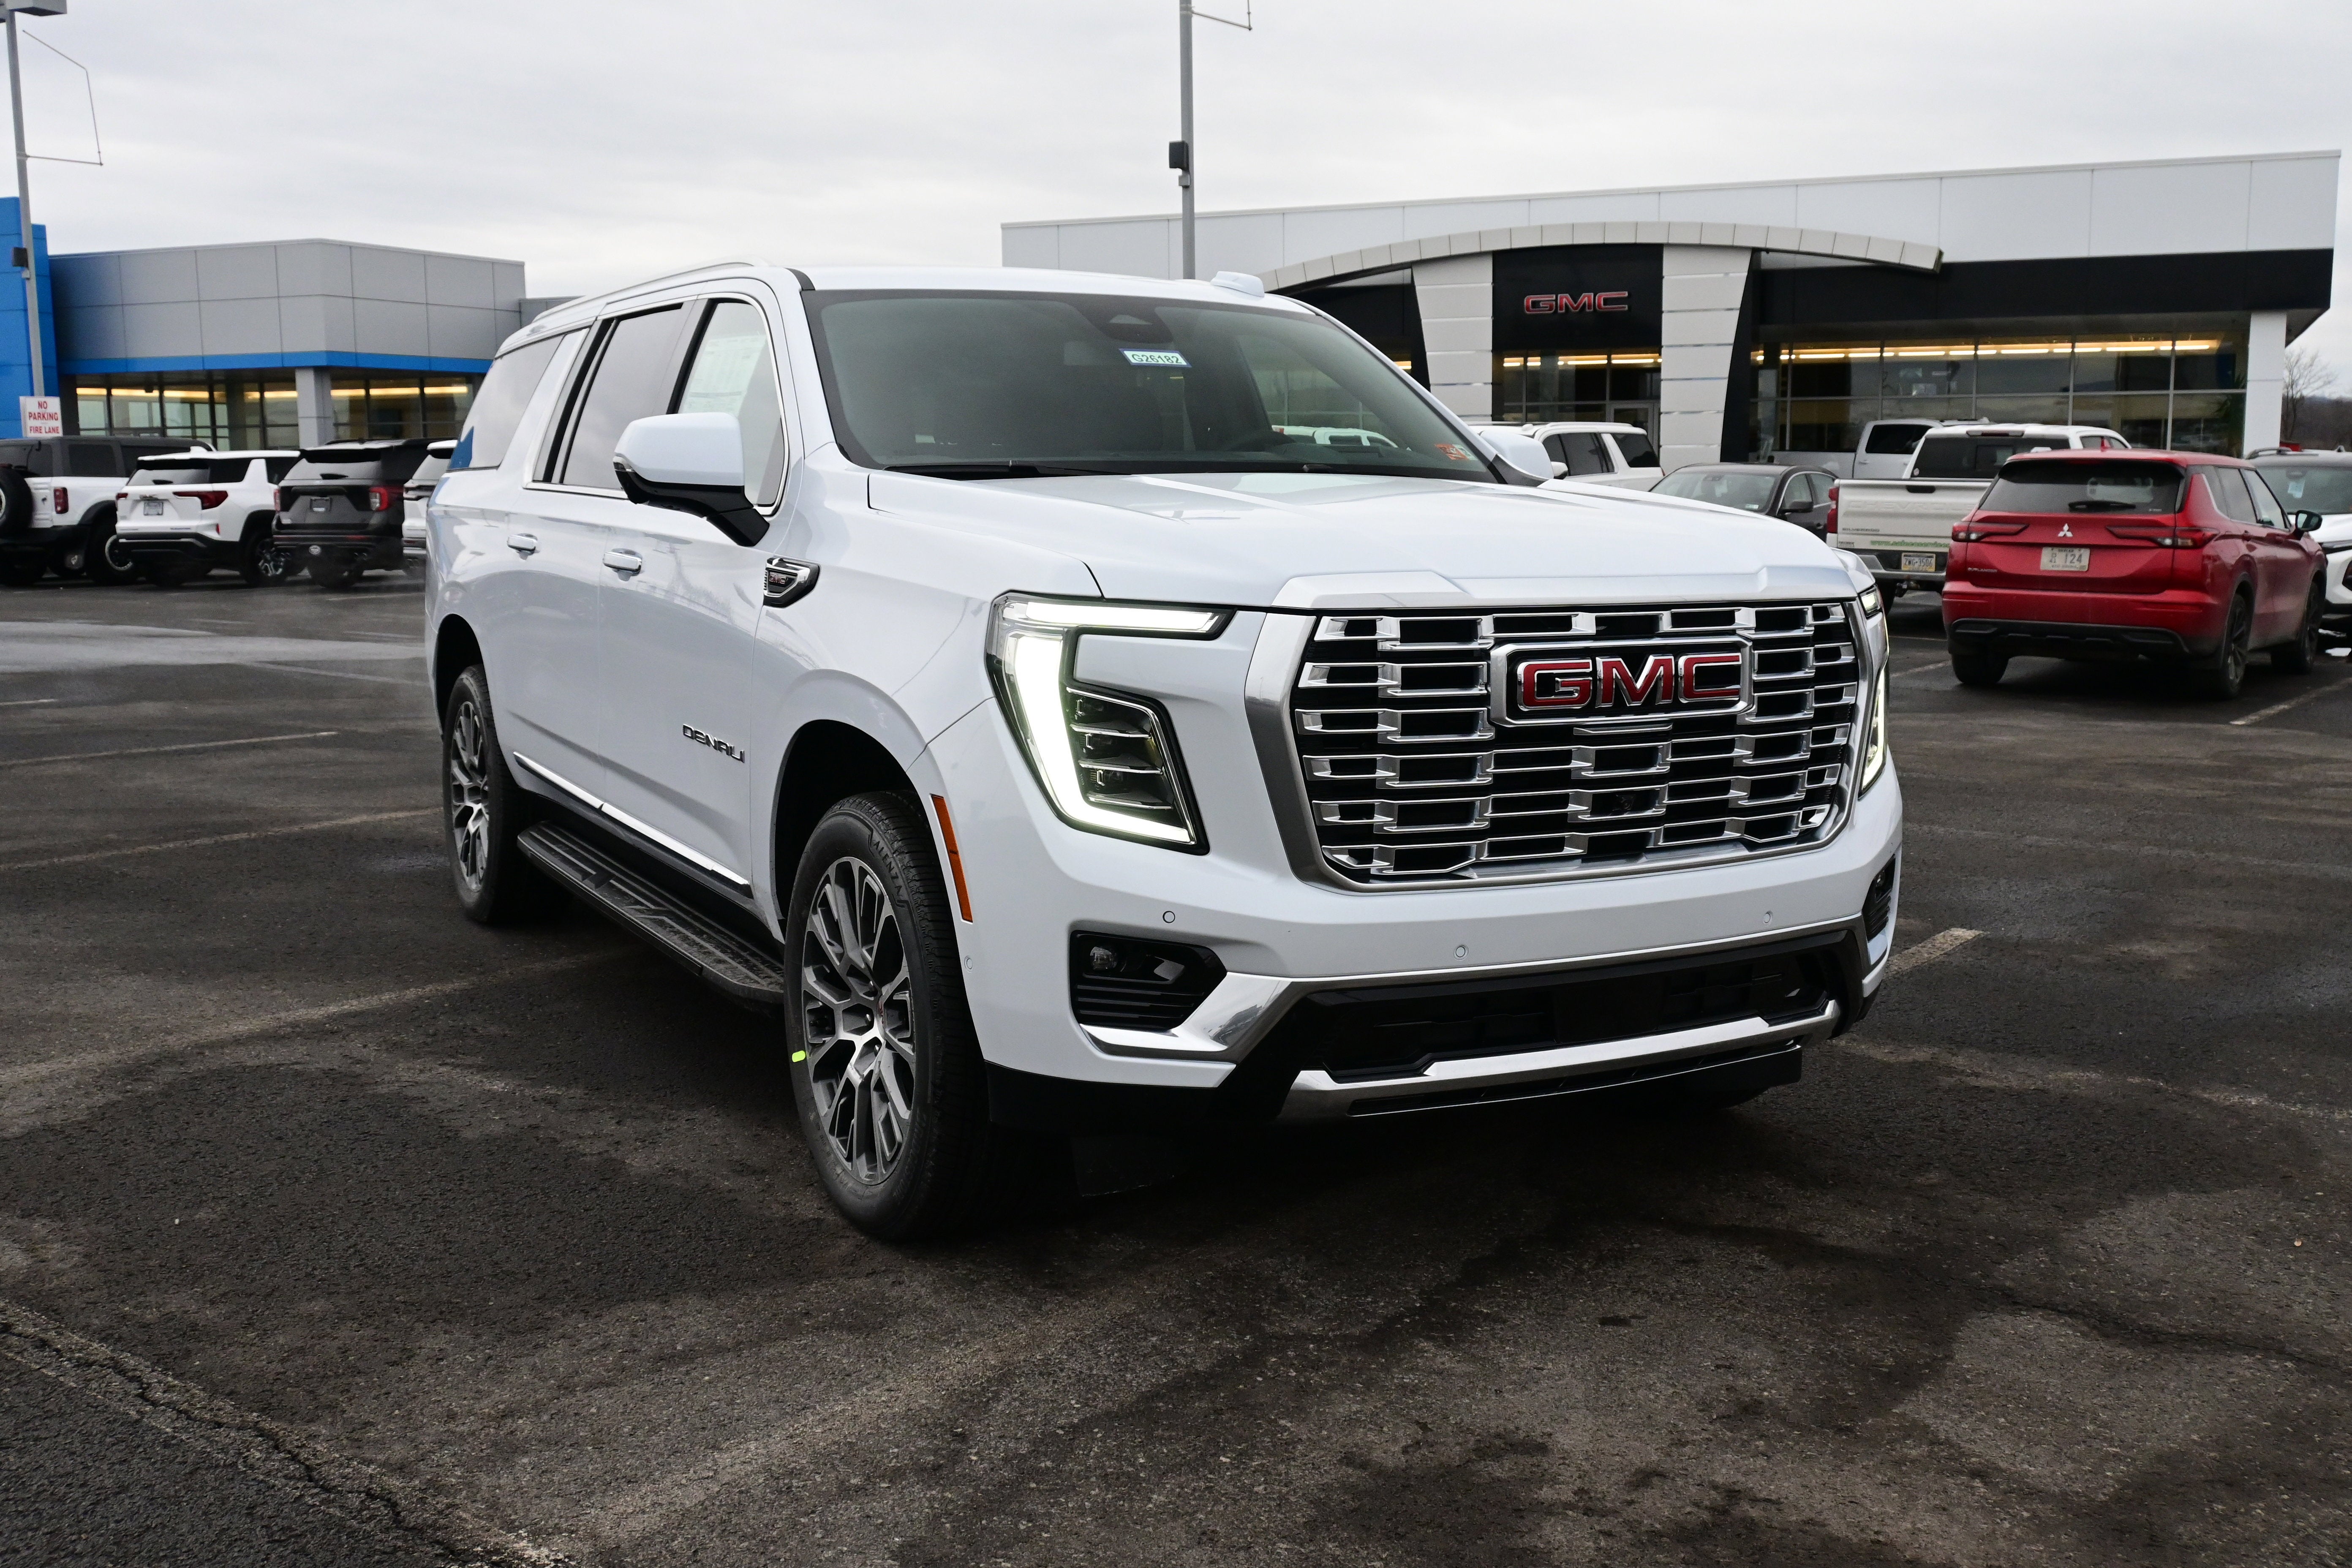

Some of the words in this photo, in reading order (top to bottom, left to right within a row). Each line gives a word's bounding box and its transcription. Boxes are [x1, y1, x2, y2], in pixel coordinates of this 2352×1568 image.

[1524, 291, 1628, 313] GMC
[1131, 354, 1182, 364] G26182
[38, 401, 47, 409] NO
[28, 412, 58, 421] PARKING
[1848, 500, 1977, 511] CHEVROLE
[2064, 553, 2082, 564] 124
[769, 571, 786, 585] GMC
[1517, 653, 1742, 711] GMC
[682, 723, 745, 763] DENALI
